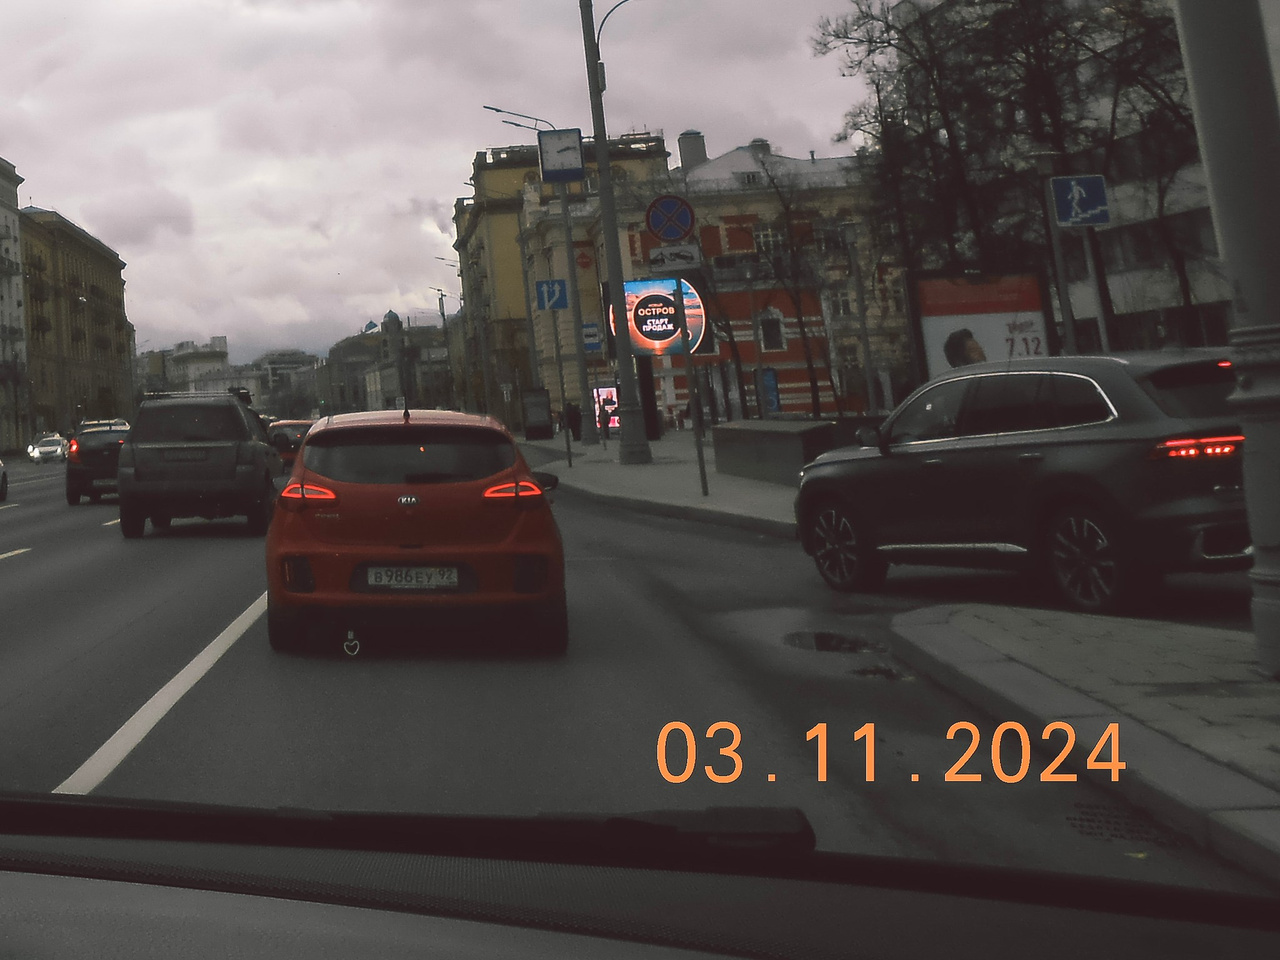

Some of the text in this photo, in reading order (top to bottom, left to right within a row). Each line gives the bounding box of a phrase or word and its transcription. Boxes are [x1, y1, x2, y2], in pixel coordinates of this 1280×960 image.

[638, 307, 675, 316] ОСТРОВ
[647, 318, 669, 326] СТАРТ
[642, 324, 675, 332] ПРОДАЖ
[1006, 336, 1043, 357] 7.12
[401, 496, 417, 504] KIA
[438, 569, 453, 580] 92
